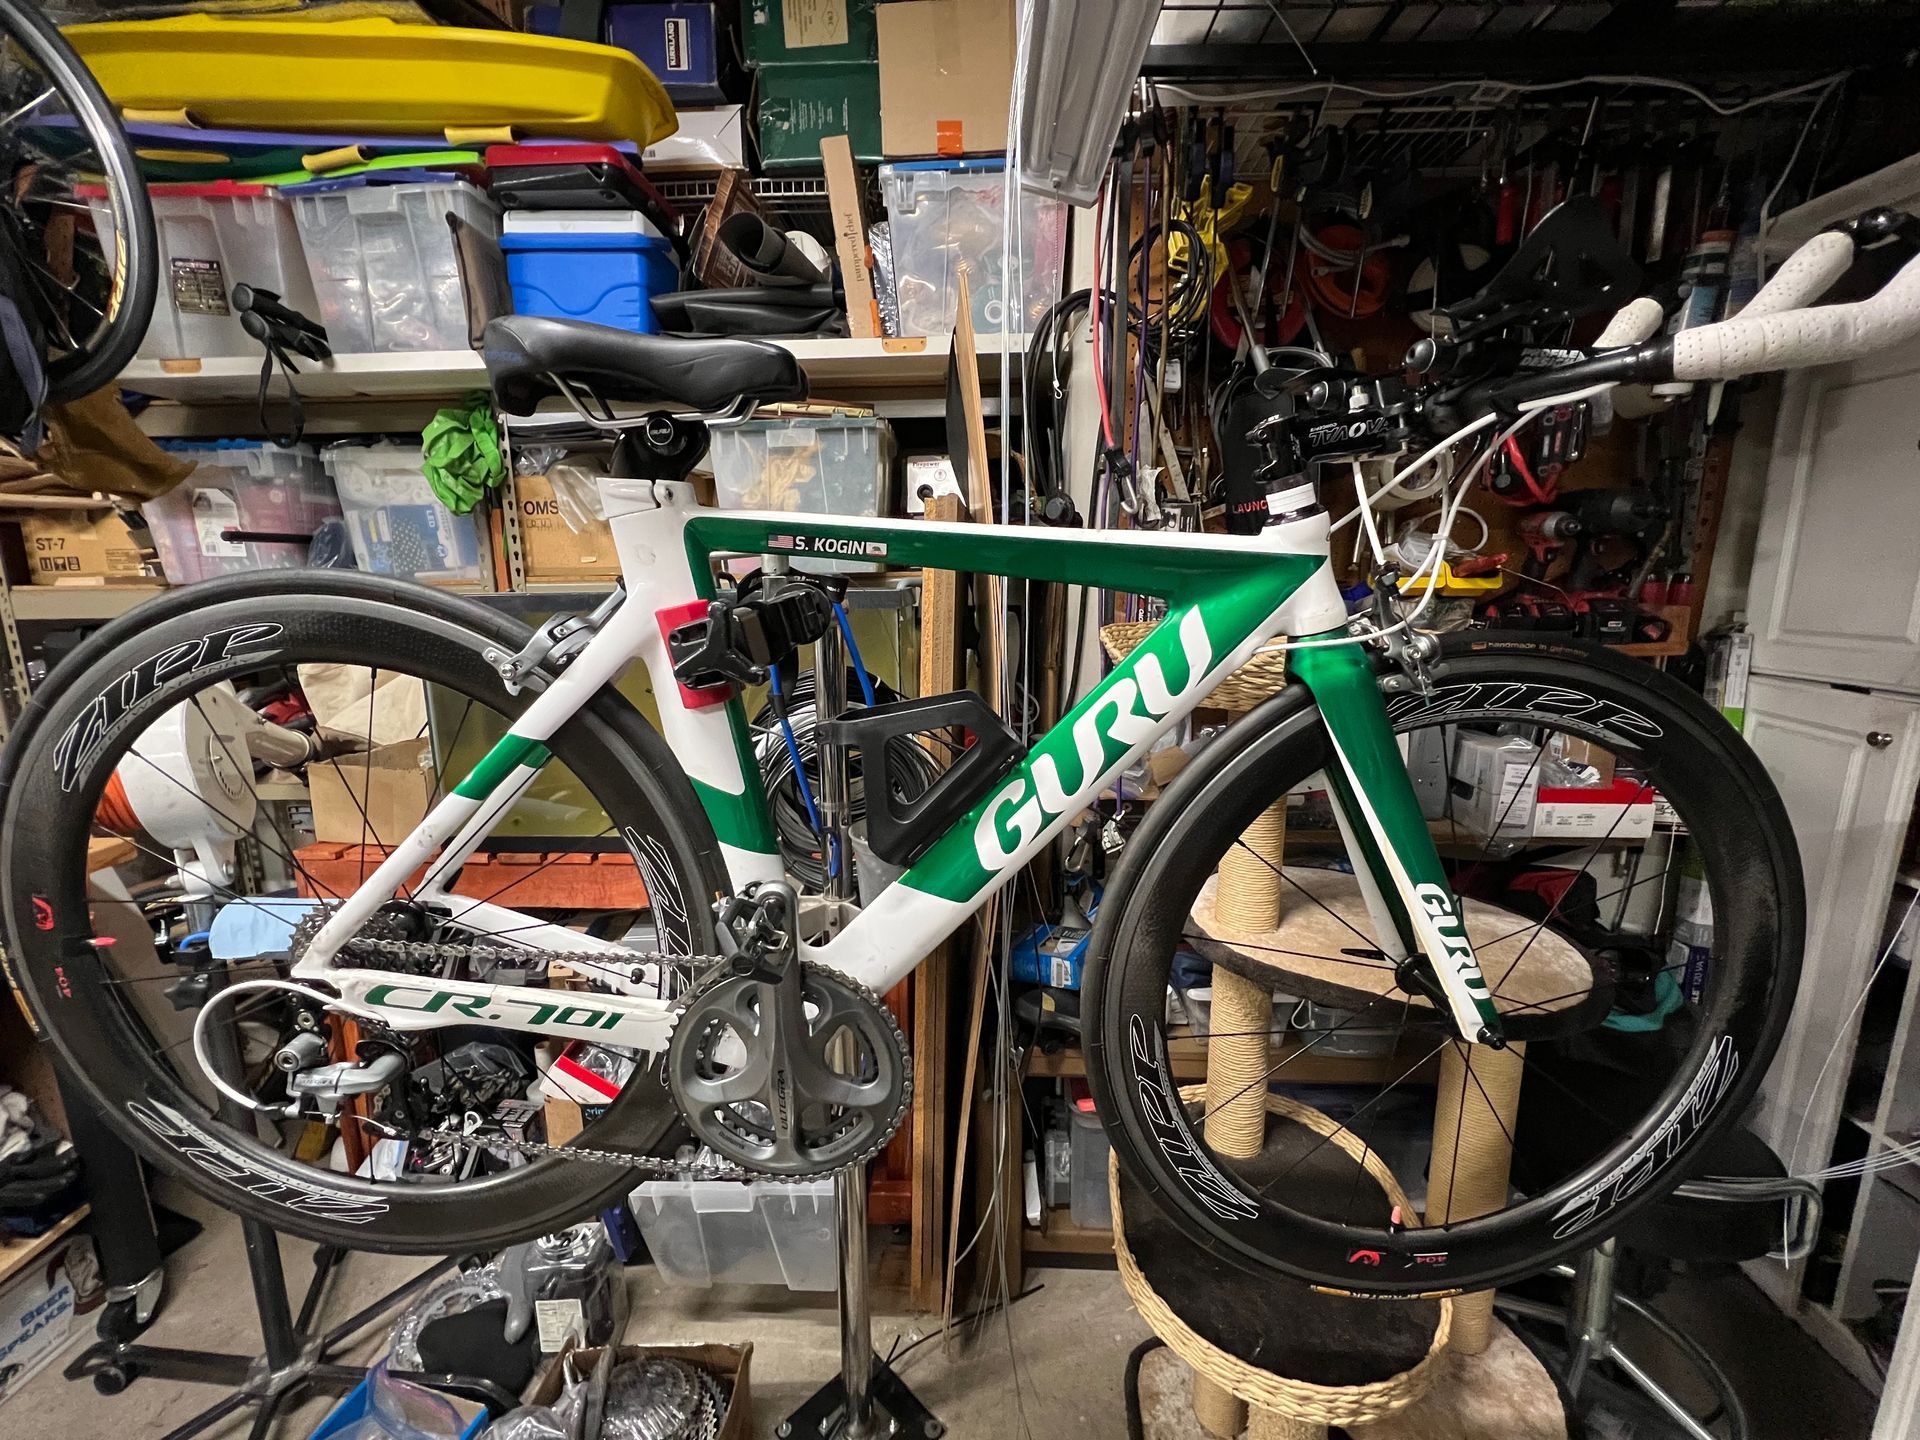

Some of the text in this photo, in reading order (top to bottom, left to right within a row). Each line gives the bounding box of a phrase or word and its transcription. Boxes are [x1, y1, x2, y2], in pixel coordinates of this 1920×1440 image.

[668, 22, 677, 66] KIRKLAND
[842, 211, 865, 282] pampered chef
[1521, 348, 1580, 358] PROFILE
[36, 538, 65, 550] ST-7
[426, 509, 436, 528] LED
[795, 536, 865, 555] S. KOGIN
[1488, 641, 1536, 650] handmade
[53, 622, 284, 793] ZIPP
[1386, 682, 1664, 738] ZIPP
[974, 604, 1212, 871] GURU
[1415, 883, 1491, 1000] GURU
[364, 984, 625, 1030] CR.701
[777, 1070, 789, 1130] ULTEGRA
[1130, 1014, 1258, 1220] ZIPP
[127, 1102, 389, 1224] ZIPP
[1553, 1036, 1739, 1239] ZIPP
[20, 1285, 70, 1328] BEER
